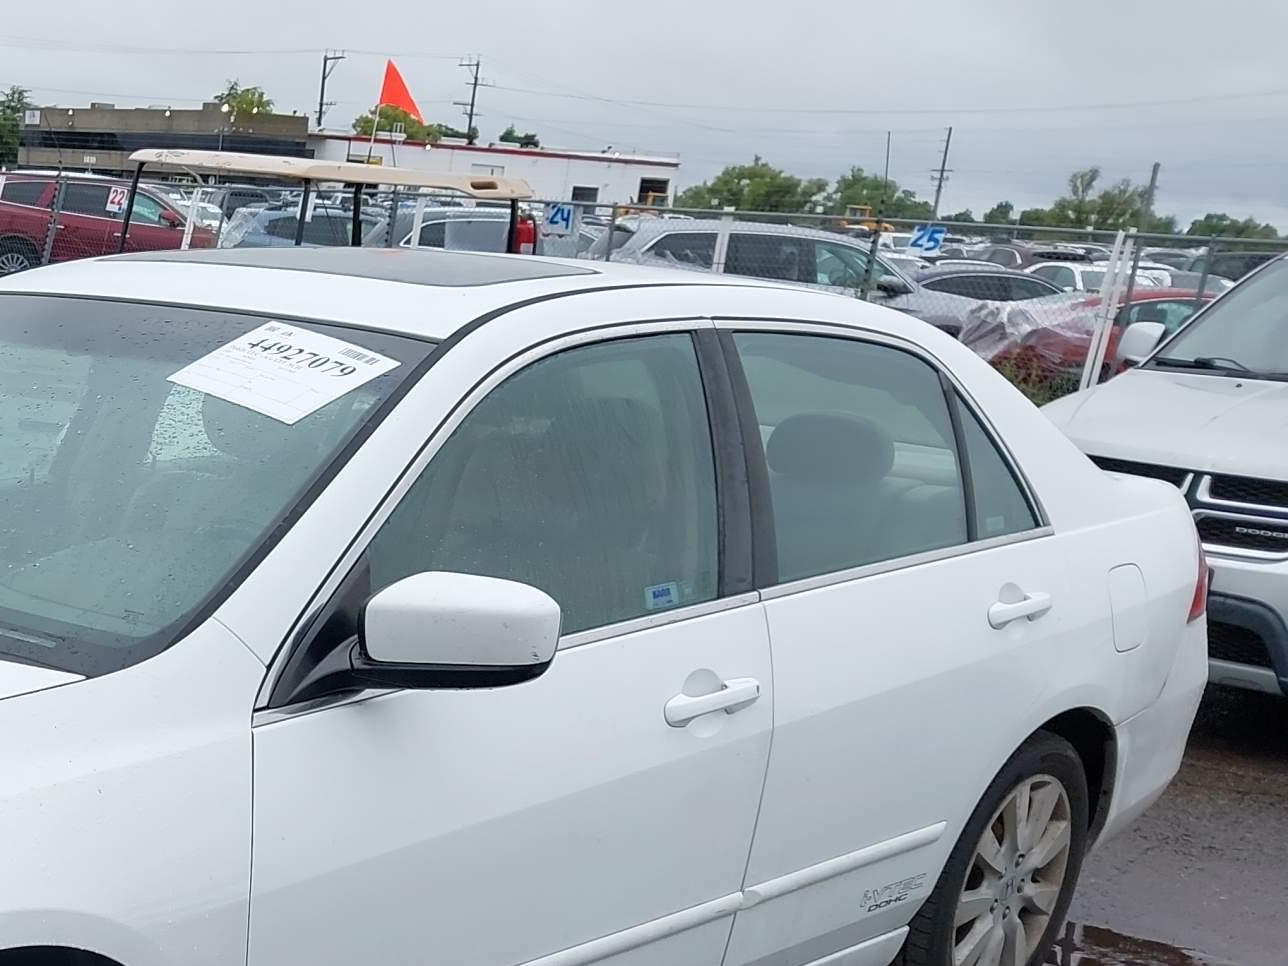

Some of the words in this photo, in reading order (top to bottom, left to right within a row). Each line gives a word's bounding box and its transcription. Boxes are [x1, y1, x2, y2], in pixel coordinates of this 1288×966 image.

[109, 189, 125, 205] 22
[548, 203, 571, 230] 24
[910, 226, 945, 251] 25
[247, 338, 357, 377] 44927079
[866, 892, 909, 912] DOHC
